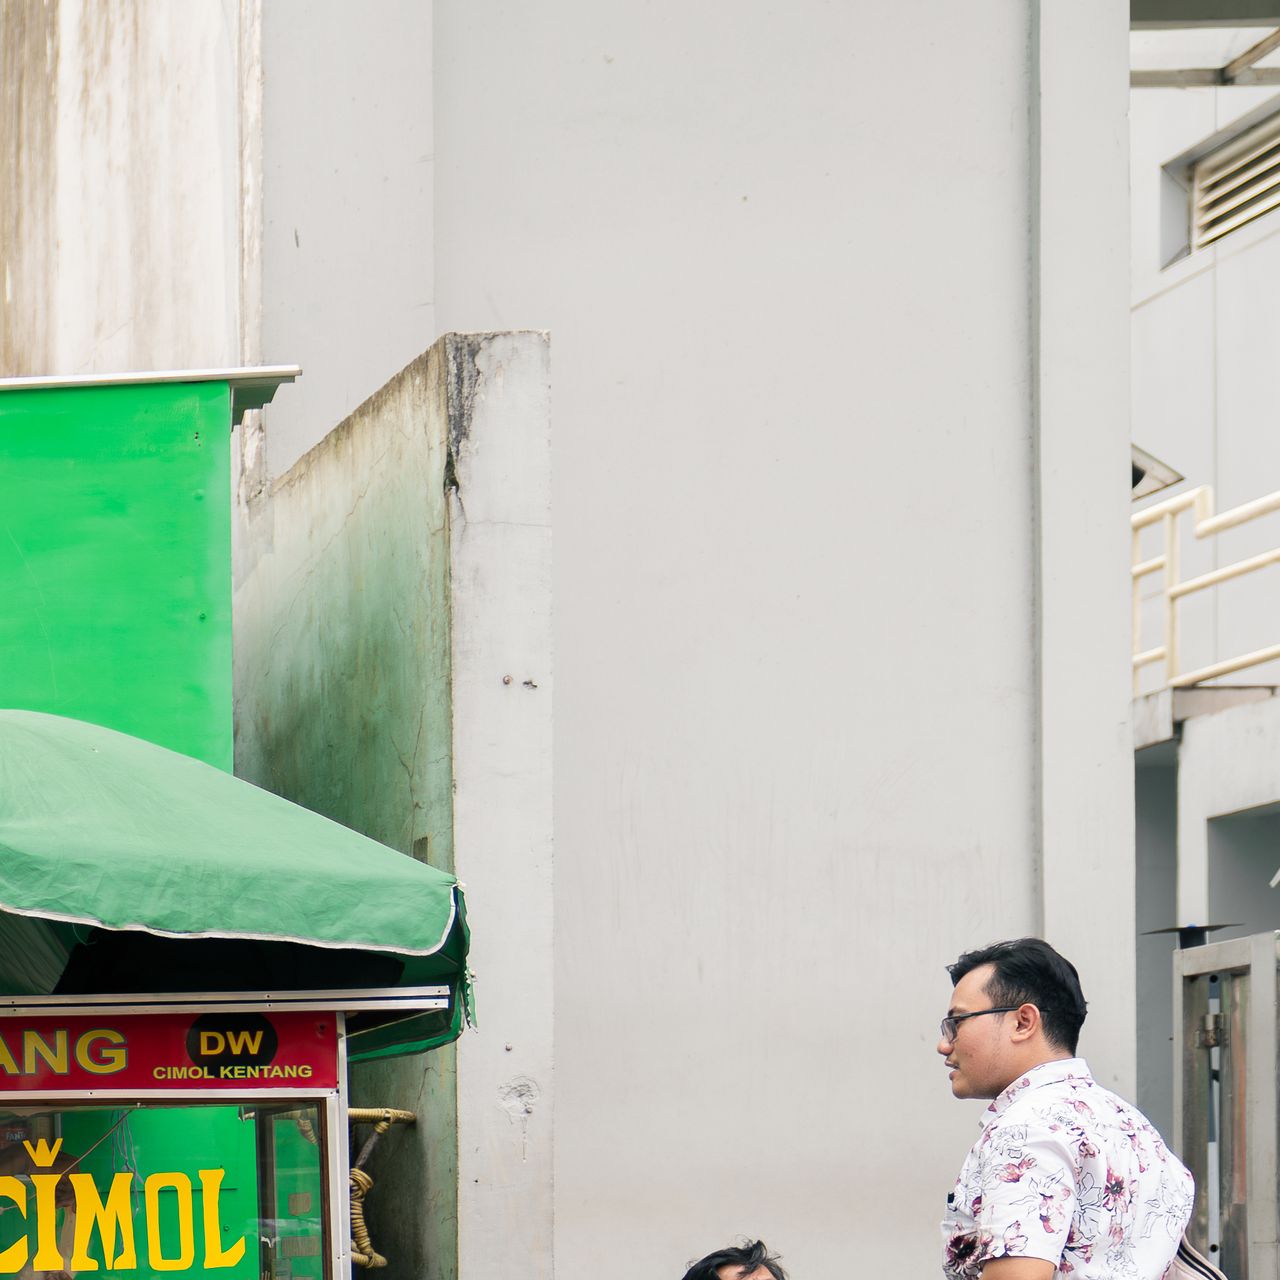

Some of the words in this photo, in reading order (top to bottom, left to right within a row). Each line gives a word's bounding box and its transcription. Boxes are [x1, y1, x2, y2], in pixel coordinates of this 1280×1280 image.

[200, 1031, 264, 1056] DW
[152, 1066, 213, 1080] CIMOL
[219, 1065, 313, 1079] KENTANG
